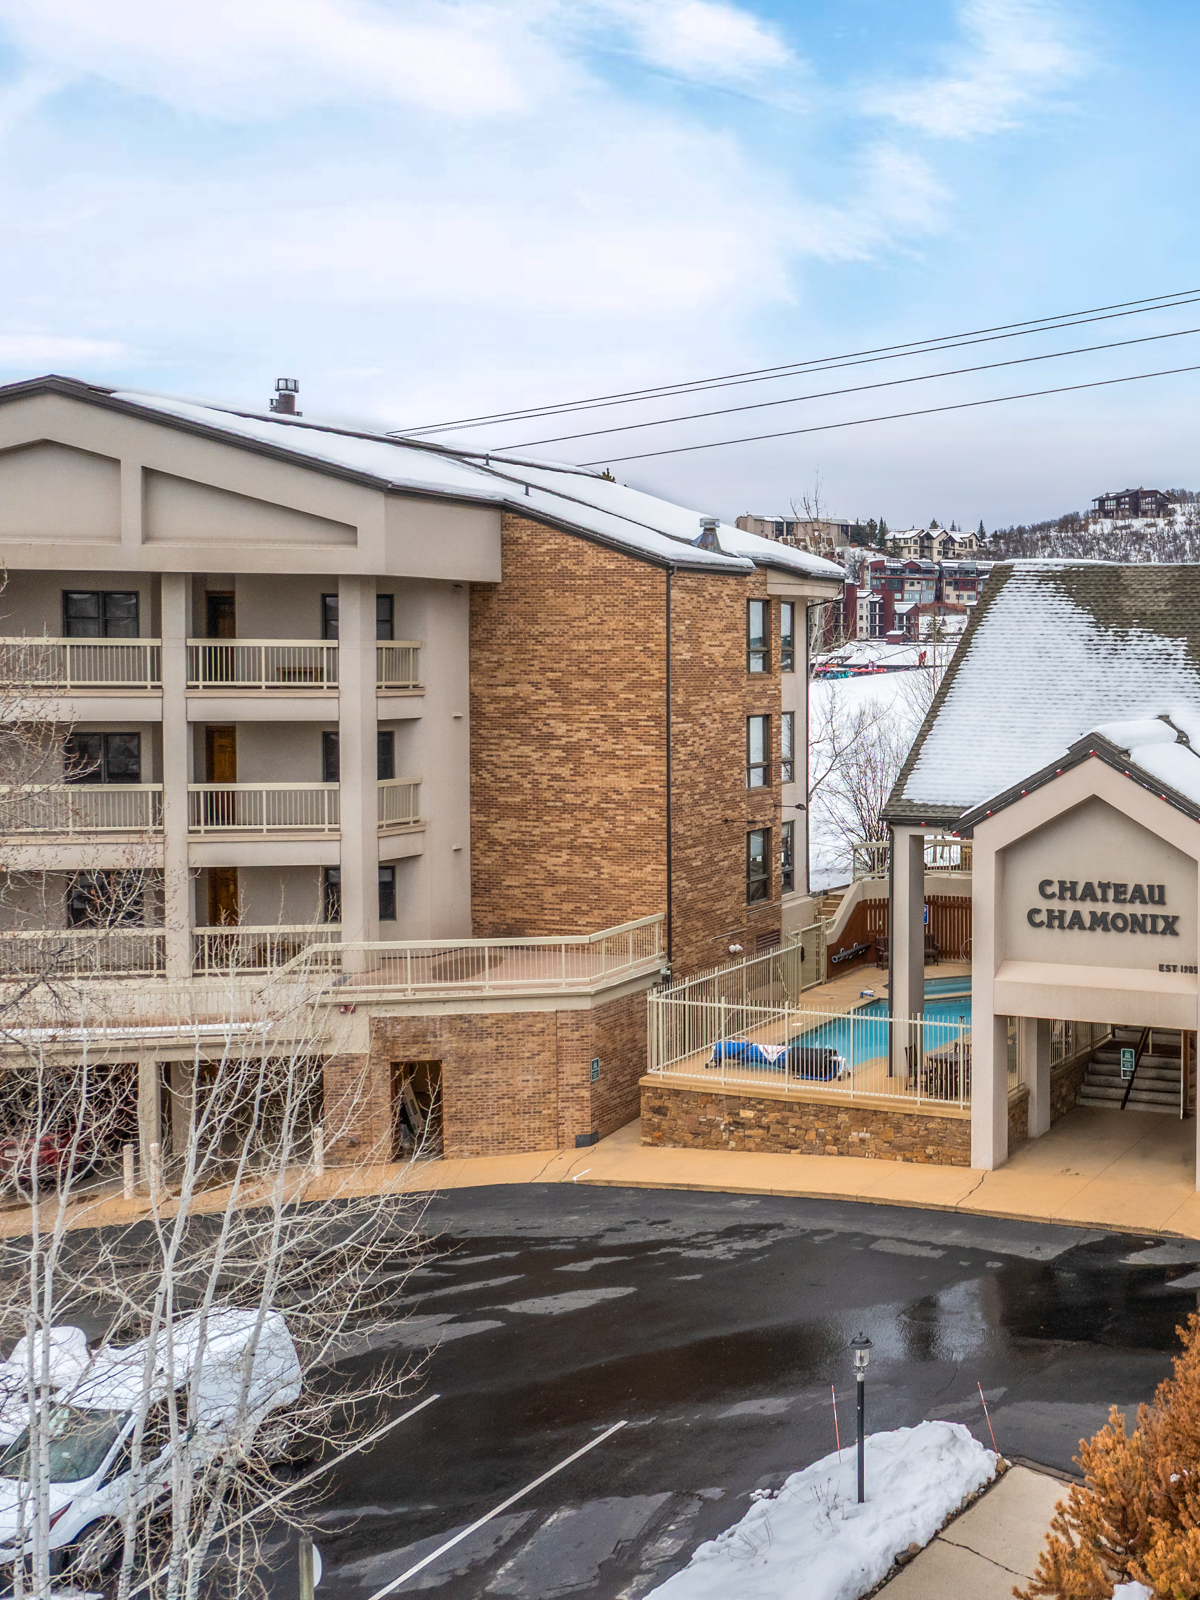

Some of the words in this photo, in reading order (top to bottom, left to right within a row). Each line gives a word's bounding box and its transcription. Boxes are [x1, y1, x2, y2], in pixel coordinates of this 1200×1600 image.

[1038, 879, 1166, 905] CHATEAU
[1026, 908, 1180, 936] CHAMONIX
[1158, 963, 1178, 973] EST
[1180, 965, 1198, 974] 1985
